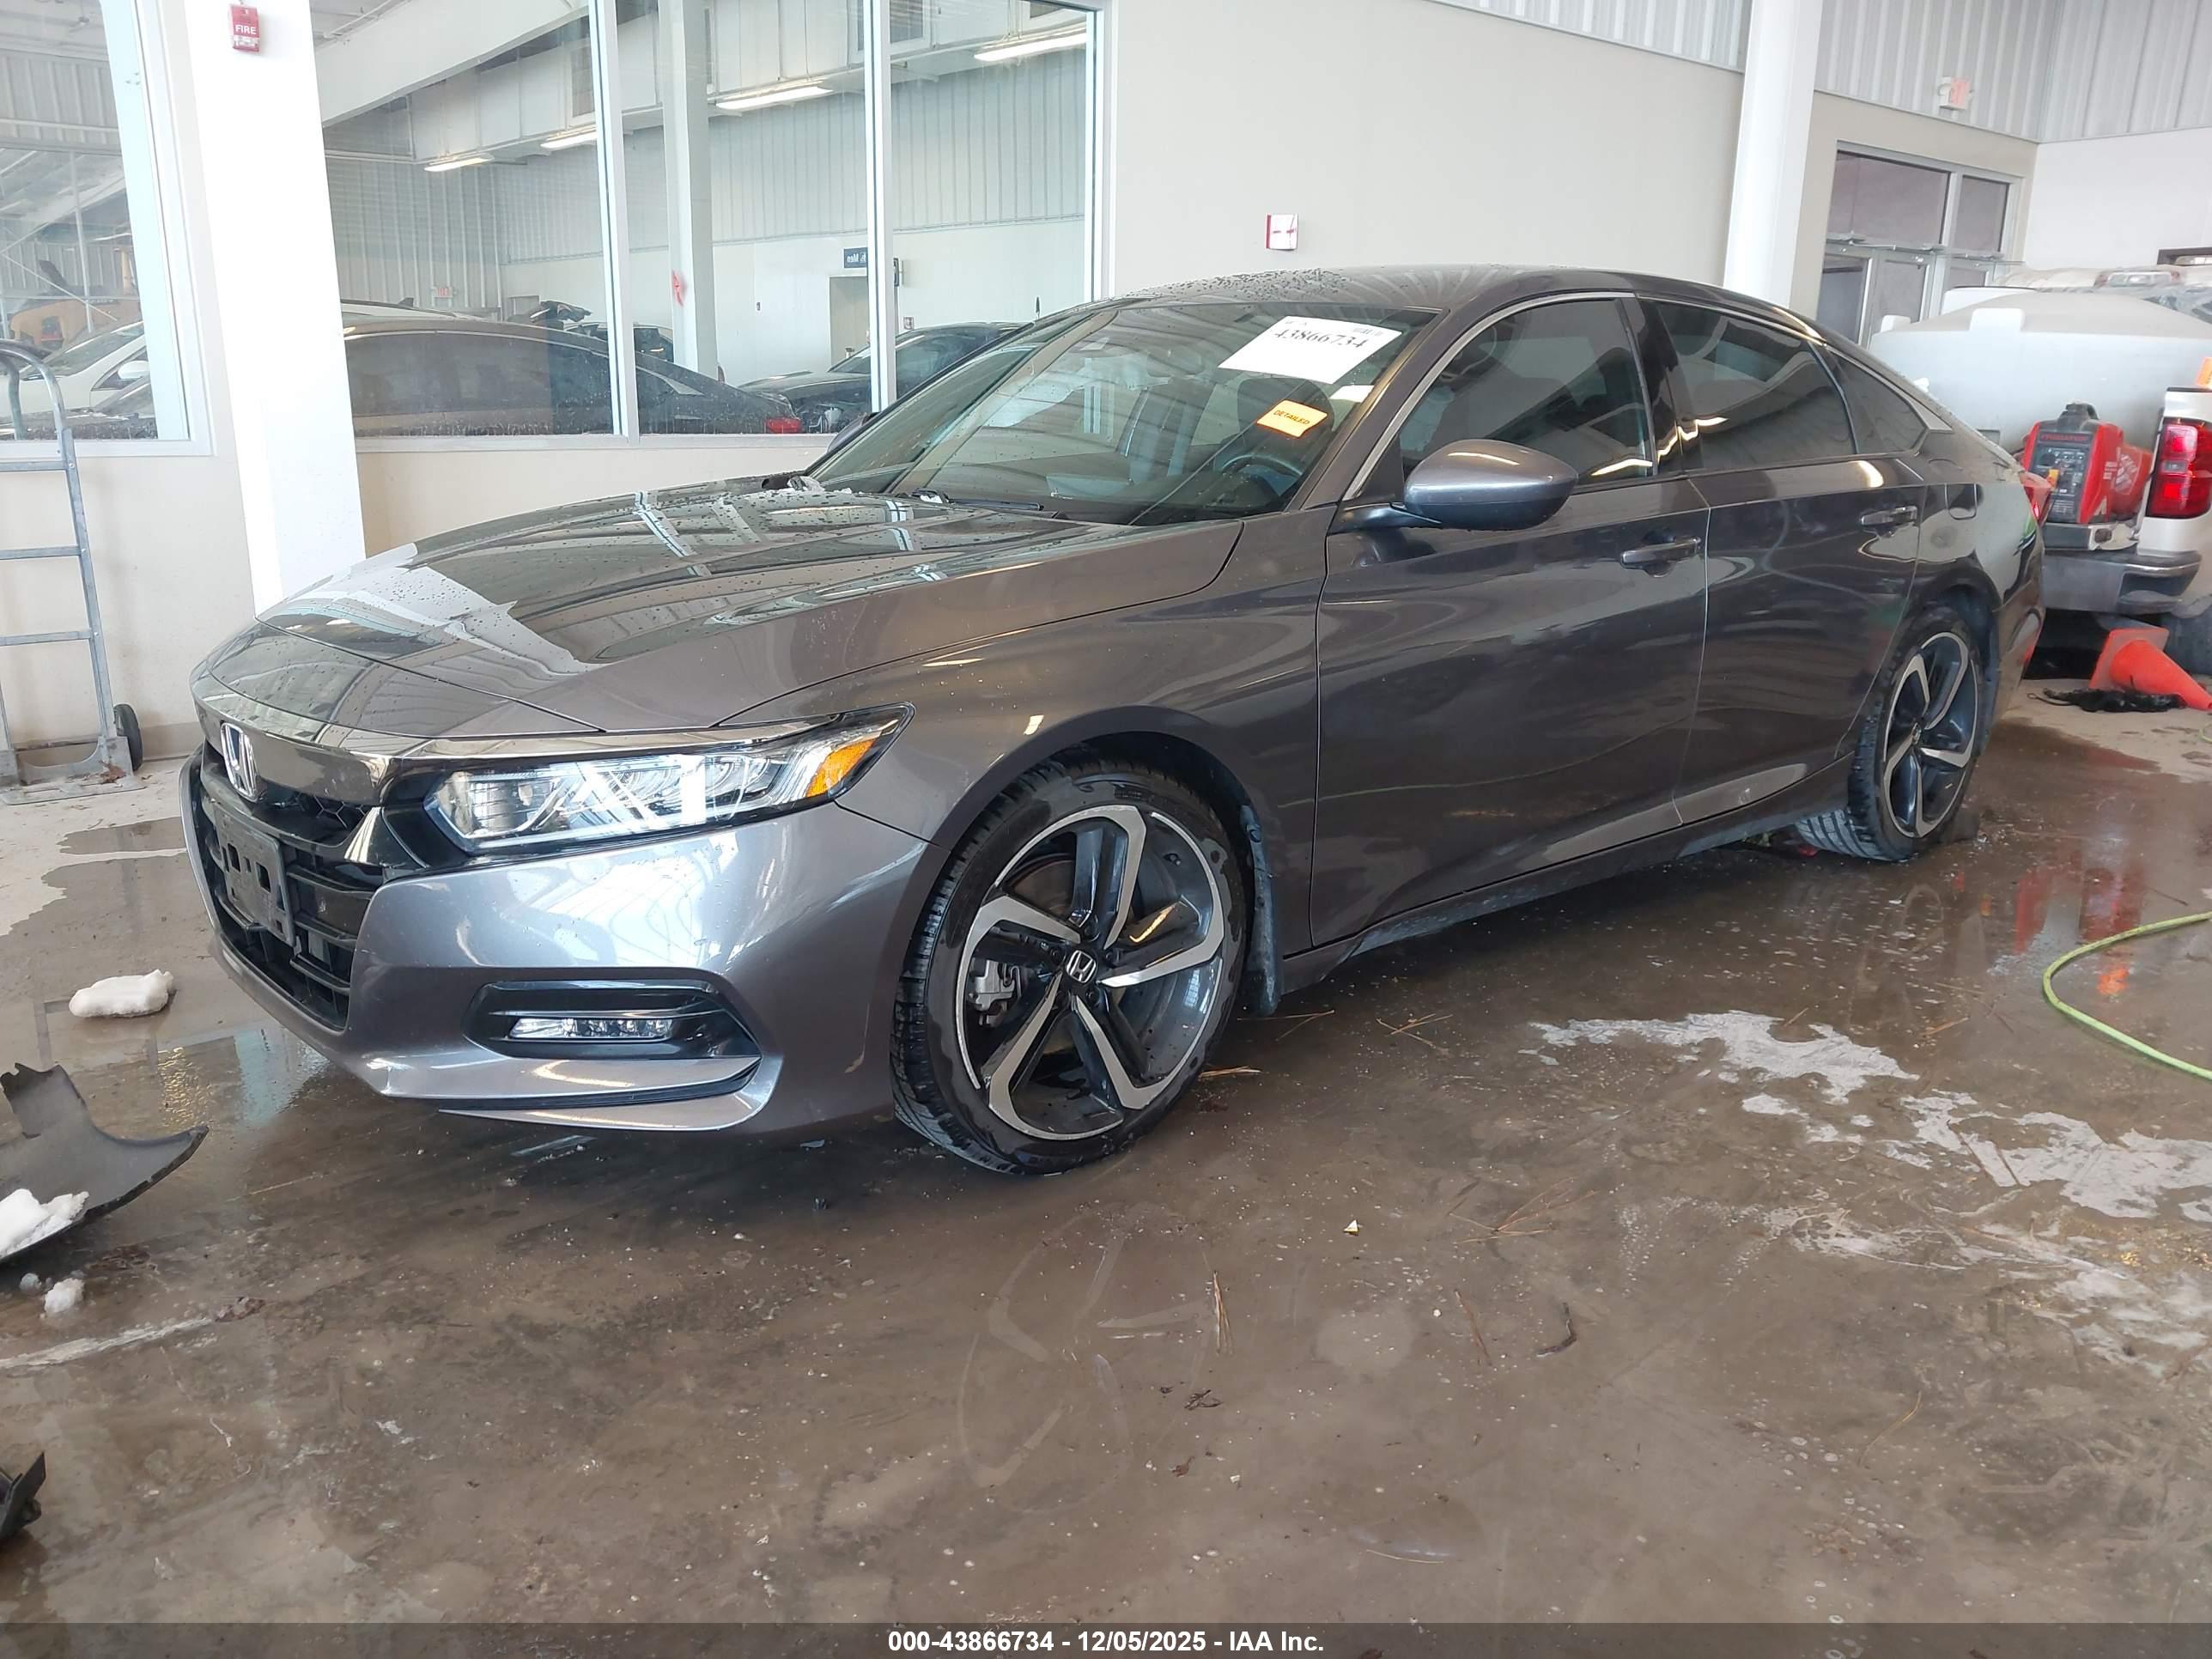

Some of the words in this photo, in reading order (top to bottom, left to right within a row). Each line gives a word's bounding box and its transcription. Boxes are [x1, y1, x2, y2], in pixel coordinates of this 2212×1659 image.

[235, 24, 257, 35] FIRE
[1274, 329, 1368, 348] 43866734
[1273, 410, 1310, 425] DETAILED
